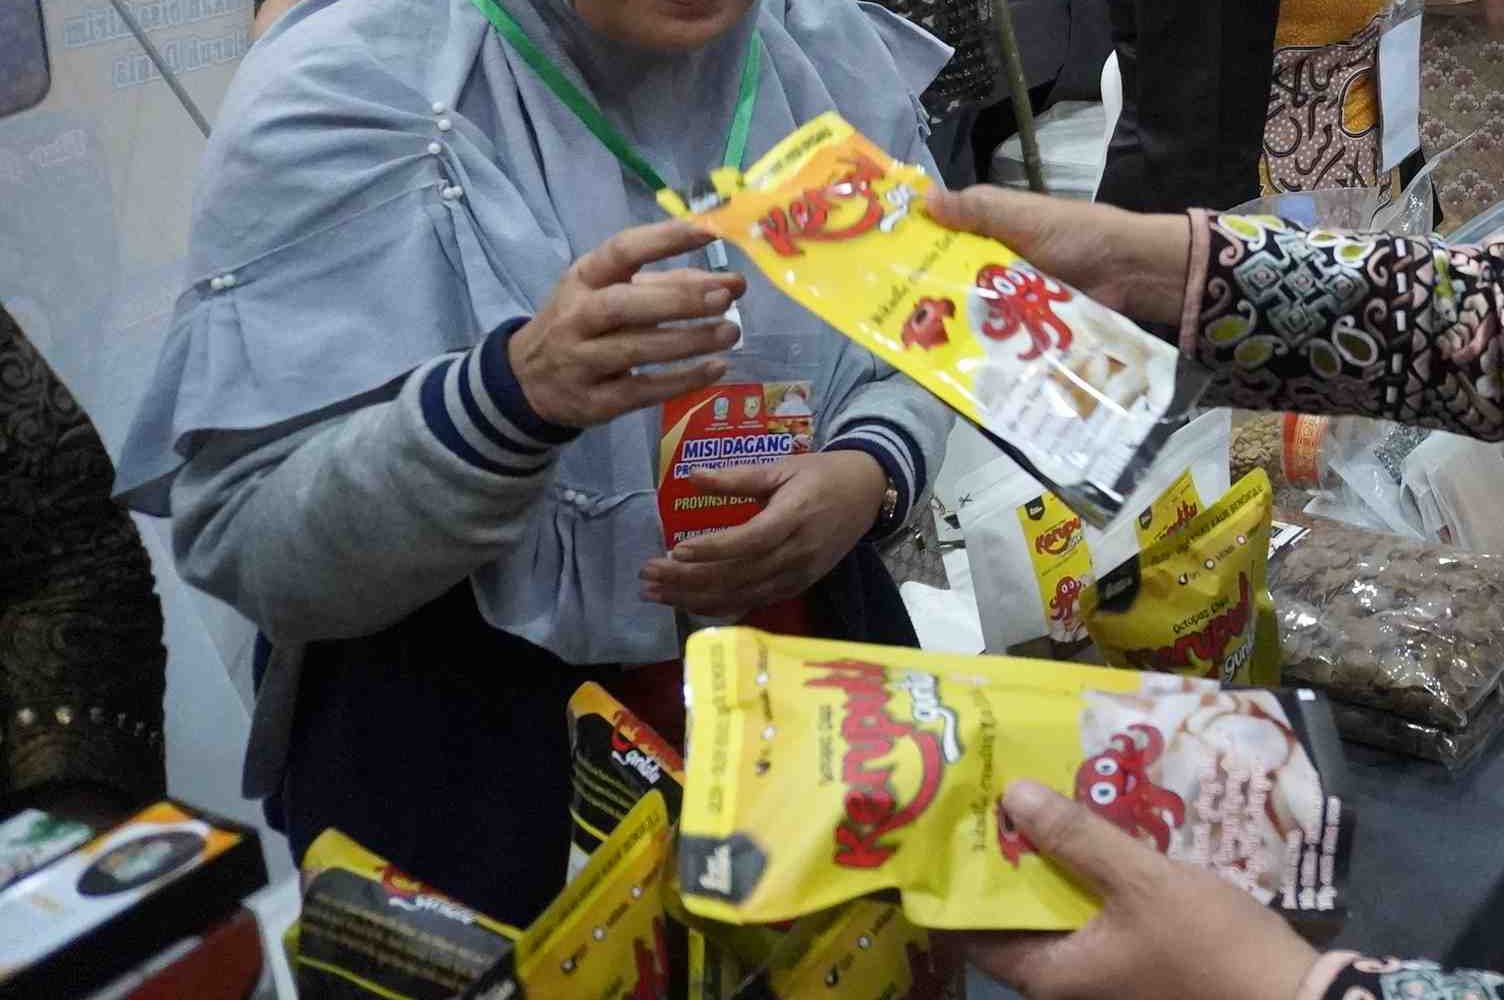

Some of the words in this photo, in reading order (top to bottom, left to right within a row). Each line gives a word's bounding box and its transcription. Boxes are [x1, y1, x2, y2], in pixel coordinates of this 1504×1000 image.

[683, 438, 721, 461] MISI
[722, 434, 791, 457] DAGANG
[674, 496, 727, 511] PROVINSI
